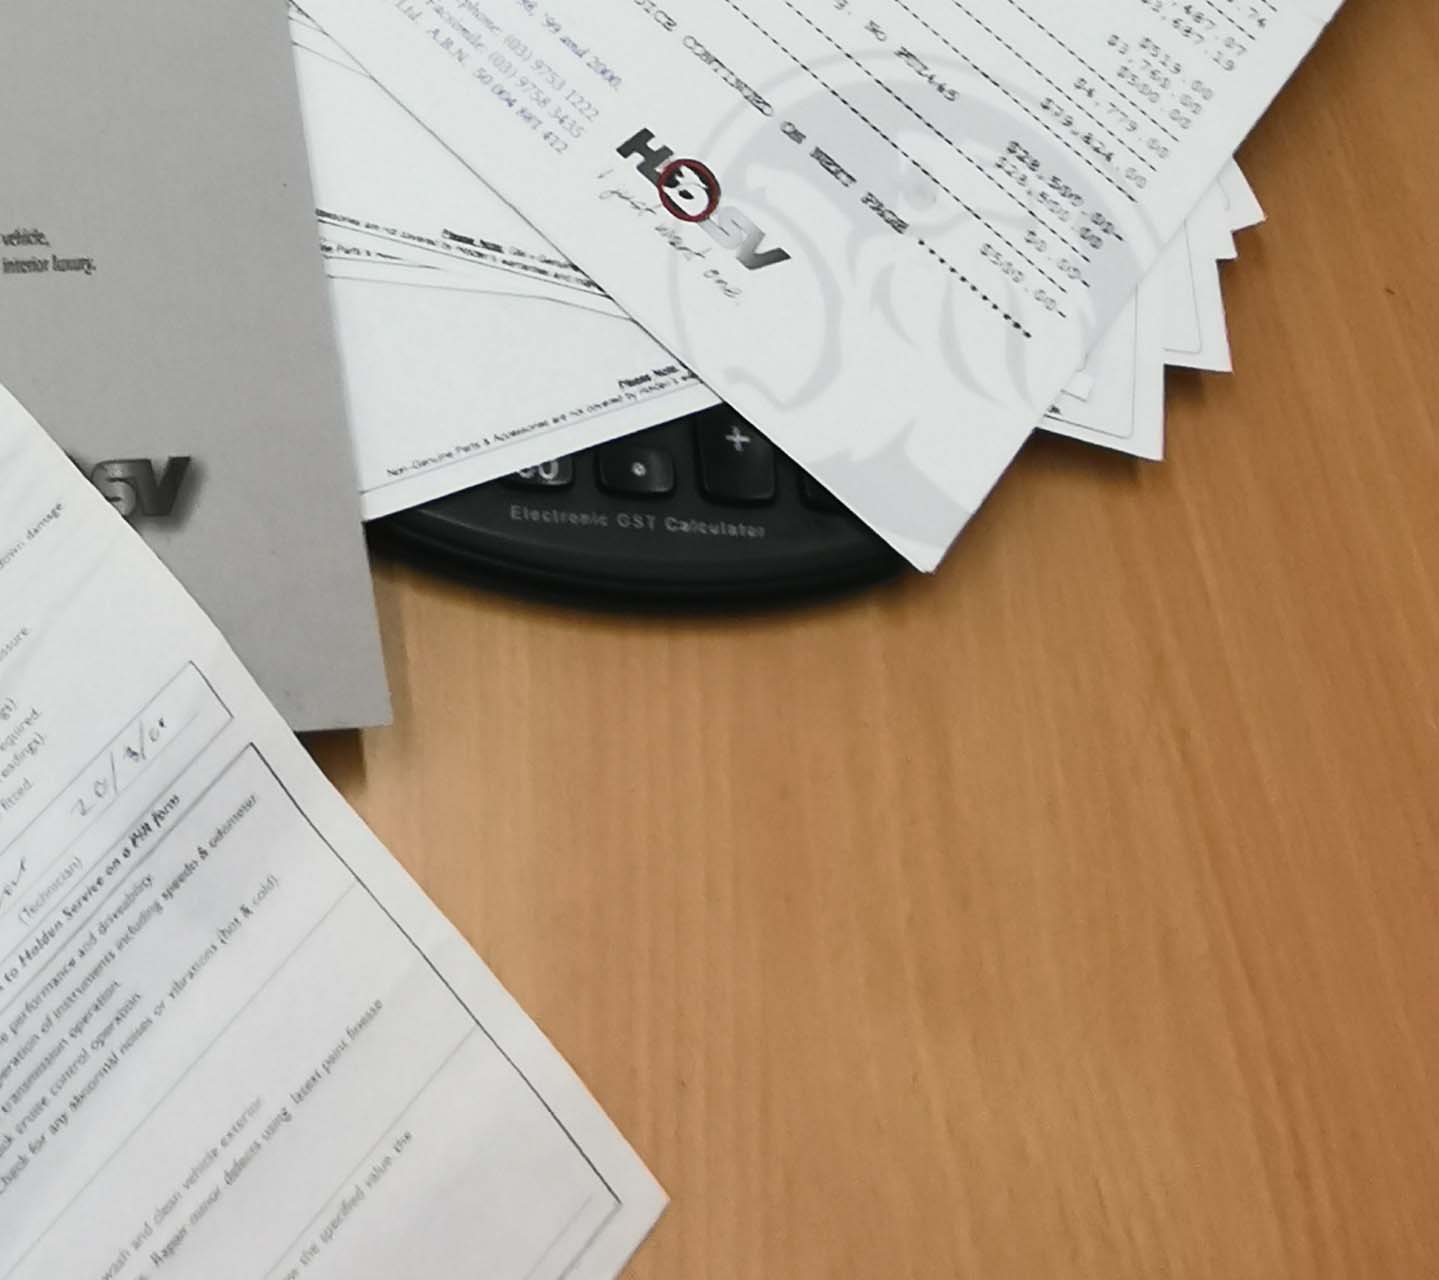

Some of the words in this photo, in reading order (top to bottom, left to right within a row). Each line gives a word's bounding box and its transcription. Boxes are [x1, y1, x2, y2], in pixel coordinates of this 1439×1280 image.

[2, 257, 49, 274] interior
[510, 503, 609, 526] Electronic
[617, 513, 656, 531] GST
[664, 517, 766, 538] Calculator
